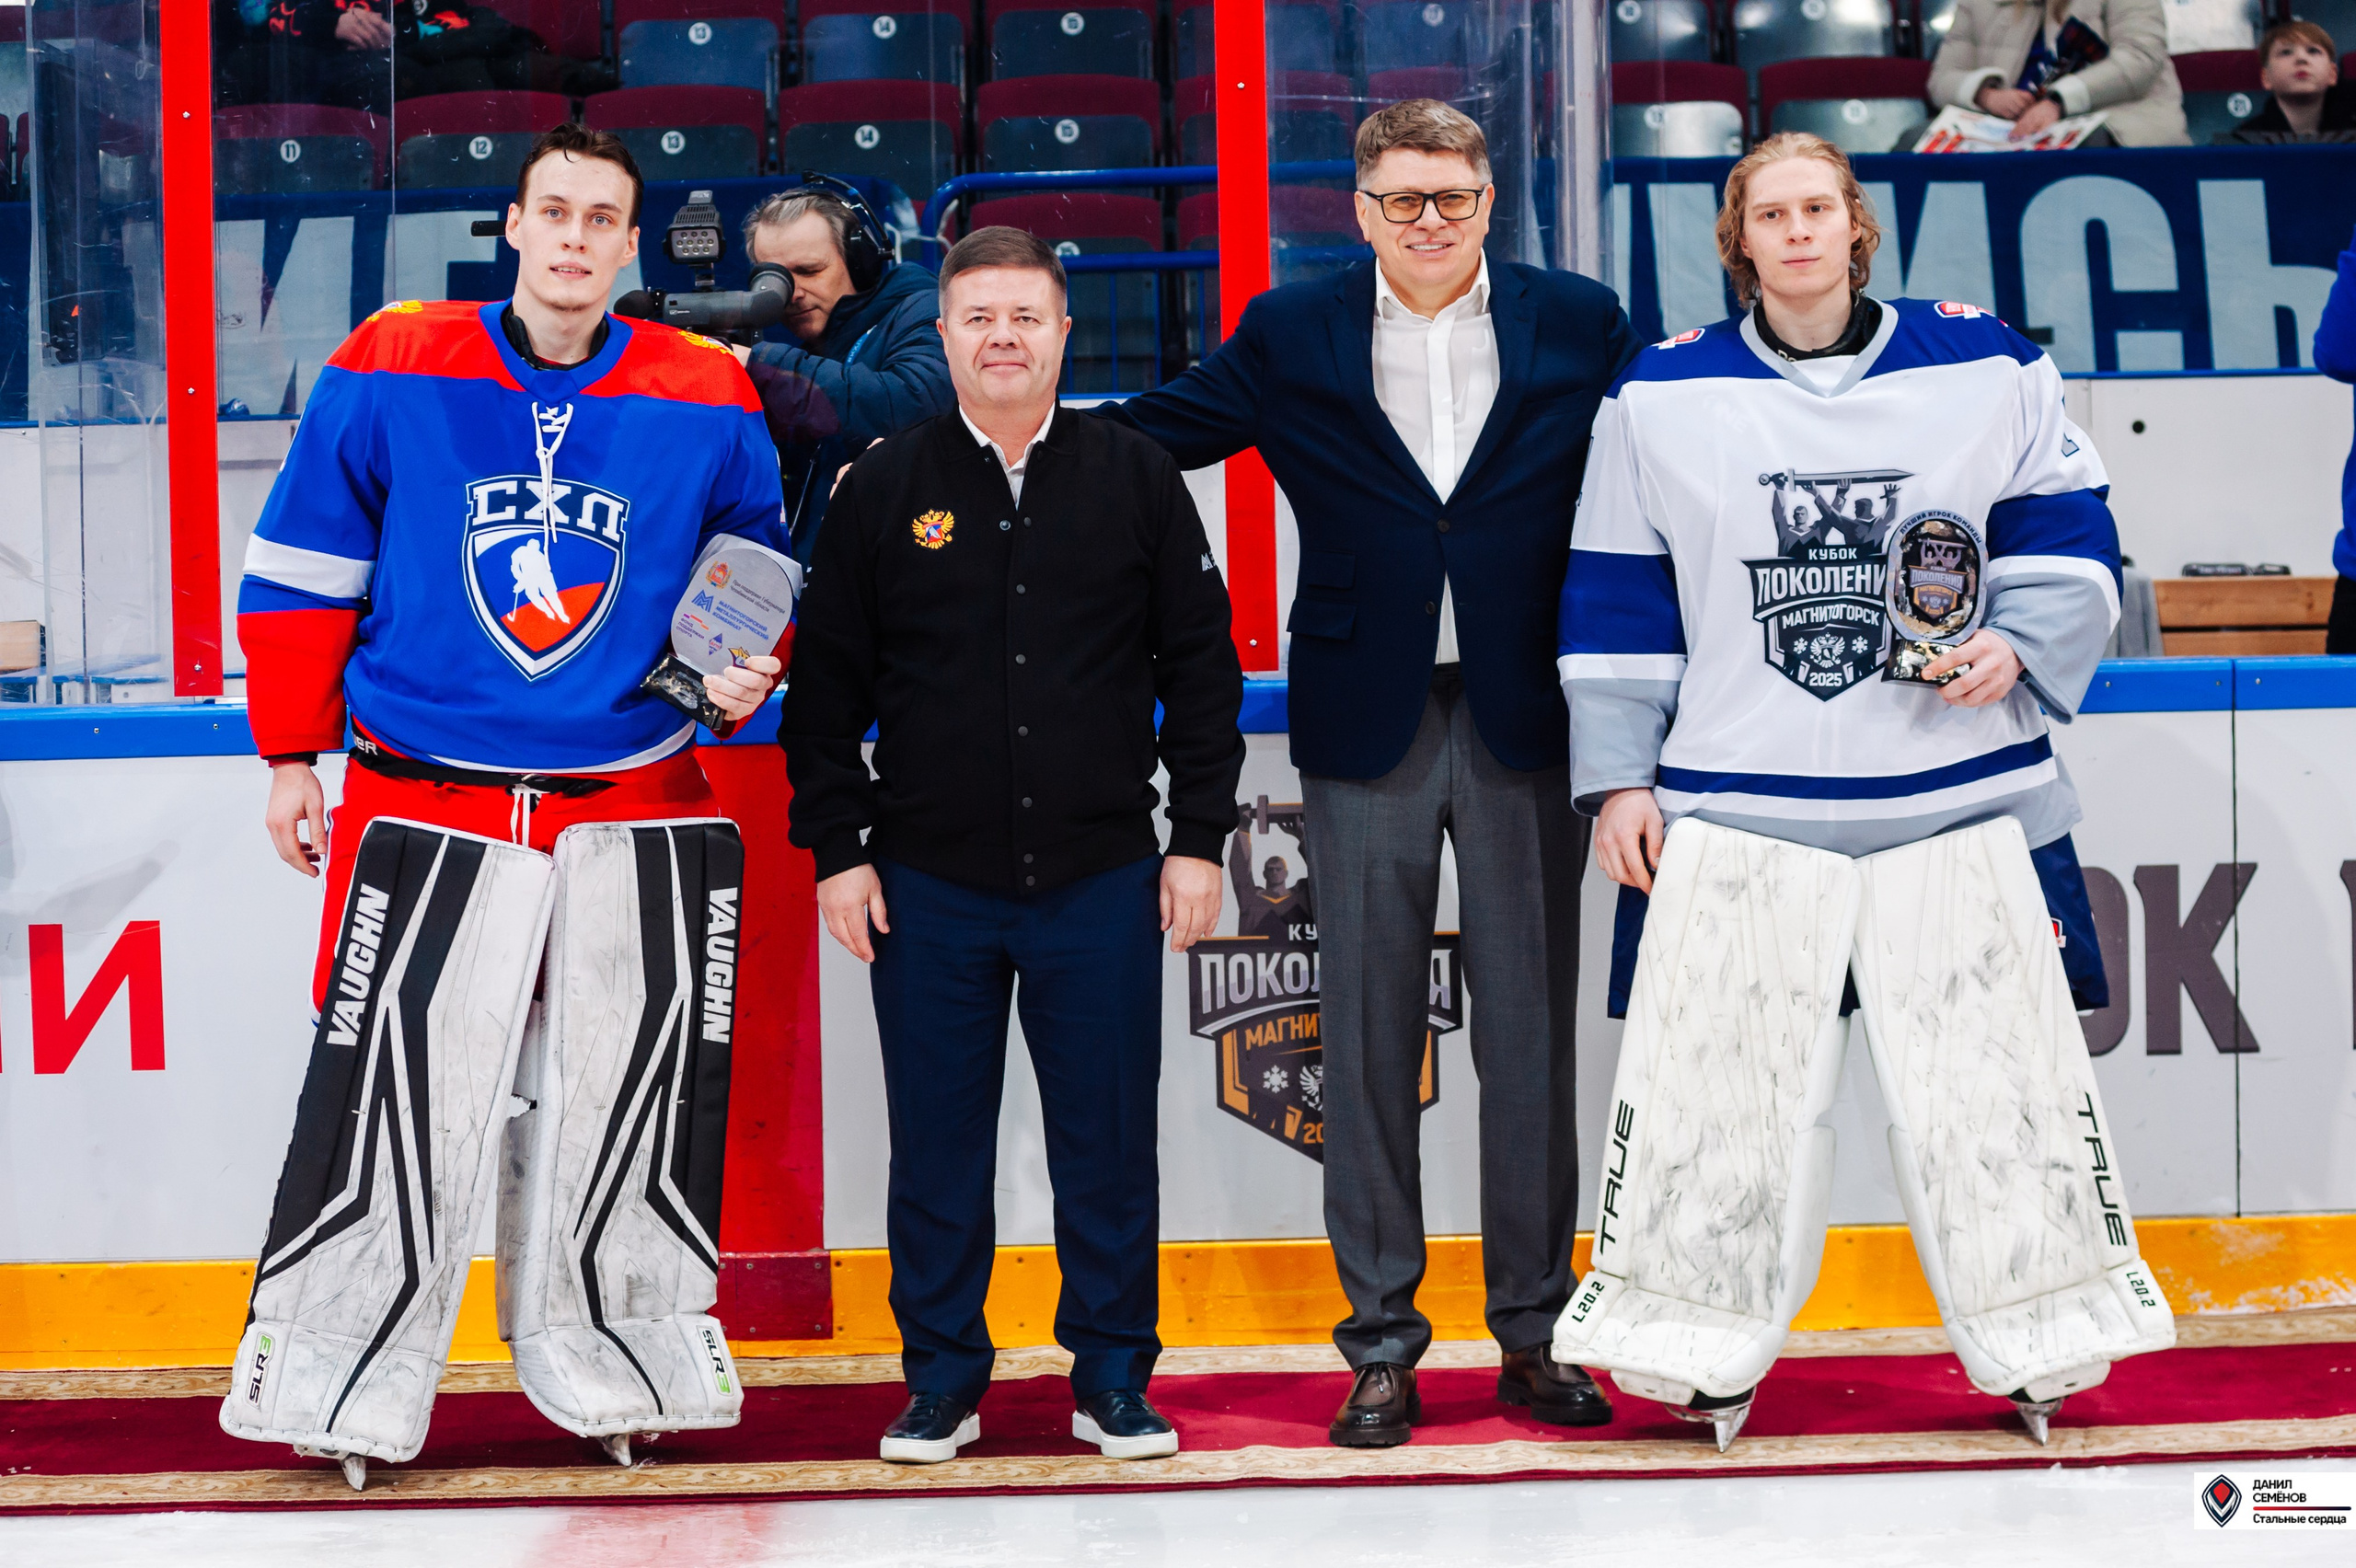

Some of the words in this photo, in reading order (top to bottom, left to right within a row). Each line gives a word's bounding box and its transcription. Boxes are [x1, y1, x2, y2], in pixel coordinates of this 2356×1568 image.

[1900, 512, 1927, 535] ЛУЧШИЙ
[1952, 514, 1982, 544] КОМАНДЫ
[1808, 548, 1858, 560] КУБОК
[1755, 564, 1887, 607] ПОКОЛЕНИ
[1911, 570, 1964, 591] ПОКОЛЕНИЯ
[711, 611, 742, 631] КОМБИНАТ
[715, 605, 769, 640] МЕТАЛЛУРГИЧЕСКИЙ
[718, 600, 768, 632] МАГНИТОГОРСКИЙ
[1782, 604, 1880, 629] МАГНИТОГОРСК
[1808, 672, 1842, 687] 2025
[327, 882, 390, 1046] VAUGHN
[702, 887, 738, 1044] VAUGHN
[0, 920, 166, 1075] И
[1245, 1012, 1322, 1051] МАГНИ
[1302, 1122, 1324, 1144] 20
[1600, 1099, 1634, 1256] TRUE
[2077, 1090, 2128, 1246] TRUE
[1571, 1280, 1605, 1323] L20.2
[2126, 1271, 2156, 1309] L20.2
[248, 1335, 271, 1403] SLR3
[702, 1330, 731, 1393] SLR3
